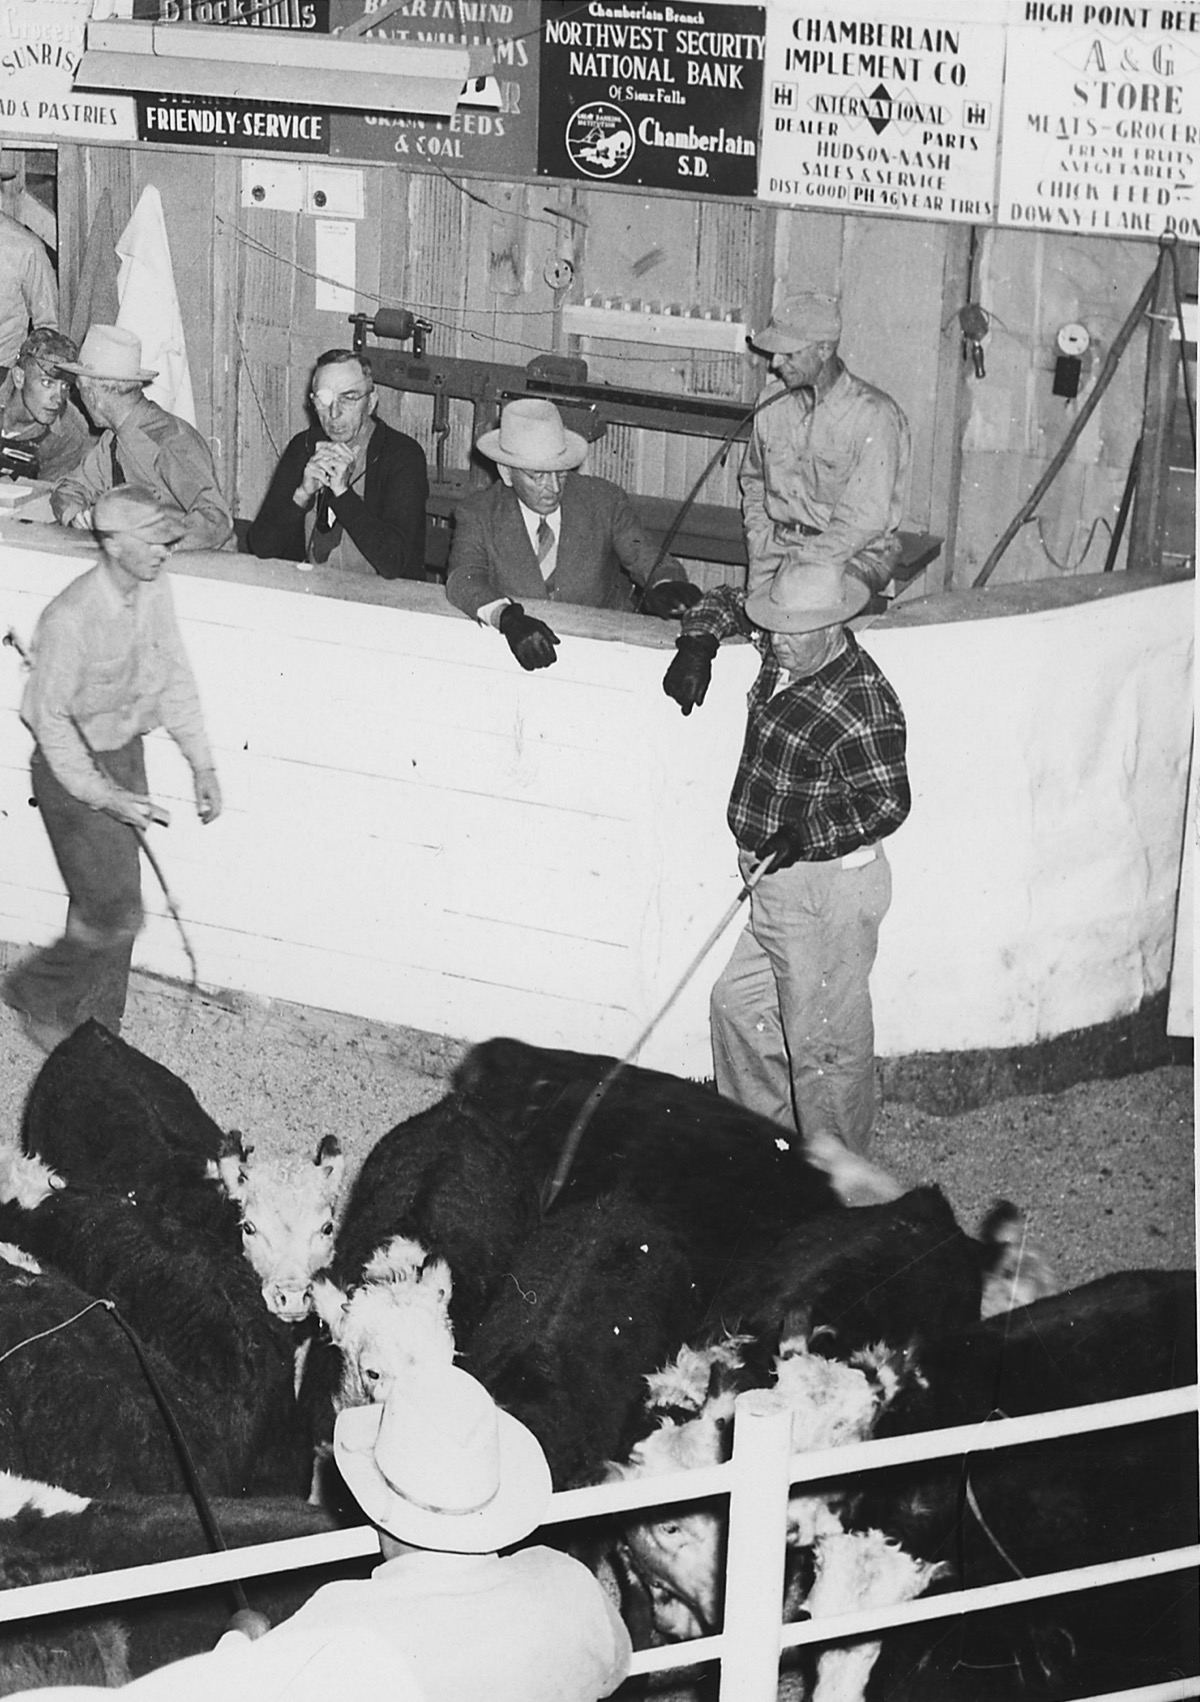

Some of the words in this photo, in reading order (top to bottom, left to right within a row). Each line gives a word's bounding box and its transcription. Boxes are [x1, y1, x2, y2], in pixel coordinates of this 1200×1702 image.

[432, 0, 455, 19] IN
[462, 2, 514, 24] MIND
[588, 2, 664, 21] Chamberlain
[665, 7, 705, 25] Branch
[1025, 2, 1073, 23] HIGH
[1084, 5, 1152, 28] POINT
[545, 19, 668, 51] NORTHWEST
[676, 29, 766, 61] SECURITY
[792, 17, 960, 55] CHAMBERLAIN
[569, 51, 675, 83] NATIONAL
[687, 60, 744, 90] BANK
[785, 47, 923, 83] IMPLEMENT
[1083, 40, 1108, 73] A
[1120, 47, 1140, 73] &
[1152, 44, 1175, 77] G
[608, 84, 623, 101] Of
[625, 85, 656, 102] Sioux
[657, 87, 687, 105] Falls
[1073, 81, 1183, 115] STORE
[20, 101, 30, 118] &
[38, 101, 117, 126] PASTRIES
[815, 94, 946, 126] INTERNATIONAL
[638, 116, 756, 157] Chamberlain
[775, 117, 838, 137] DEALER
[394, 134, 410, 154] &
[416, 135, 465, 159] COAL
[816, 140, 951, 171] HUDSON-NASH
[922, 131, 979, 152] PARTS
[1068, 144, 1123, 159] FRESH
[1133, 148, 1194, 165] FRUITS
[677, 154, 710, 178] S.D.
[801, 161, 855, 181] SALES
[861, 167, 871, 183] &
[876, 169, 947, 191] SERVICE
[805, 181, 847, 200] GOOD
[901, 192, 944, 211] YEAR
[950, 198, 992, 216] TIRES
[1037, 180, 1099, 201] CHICK
[1112, 184, 1171, 206] FEED
